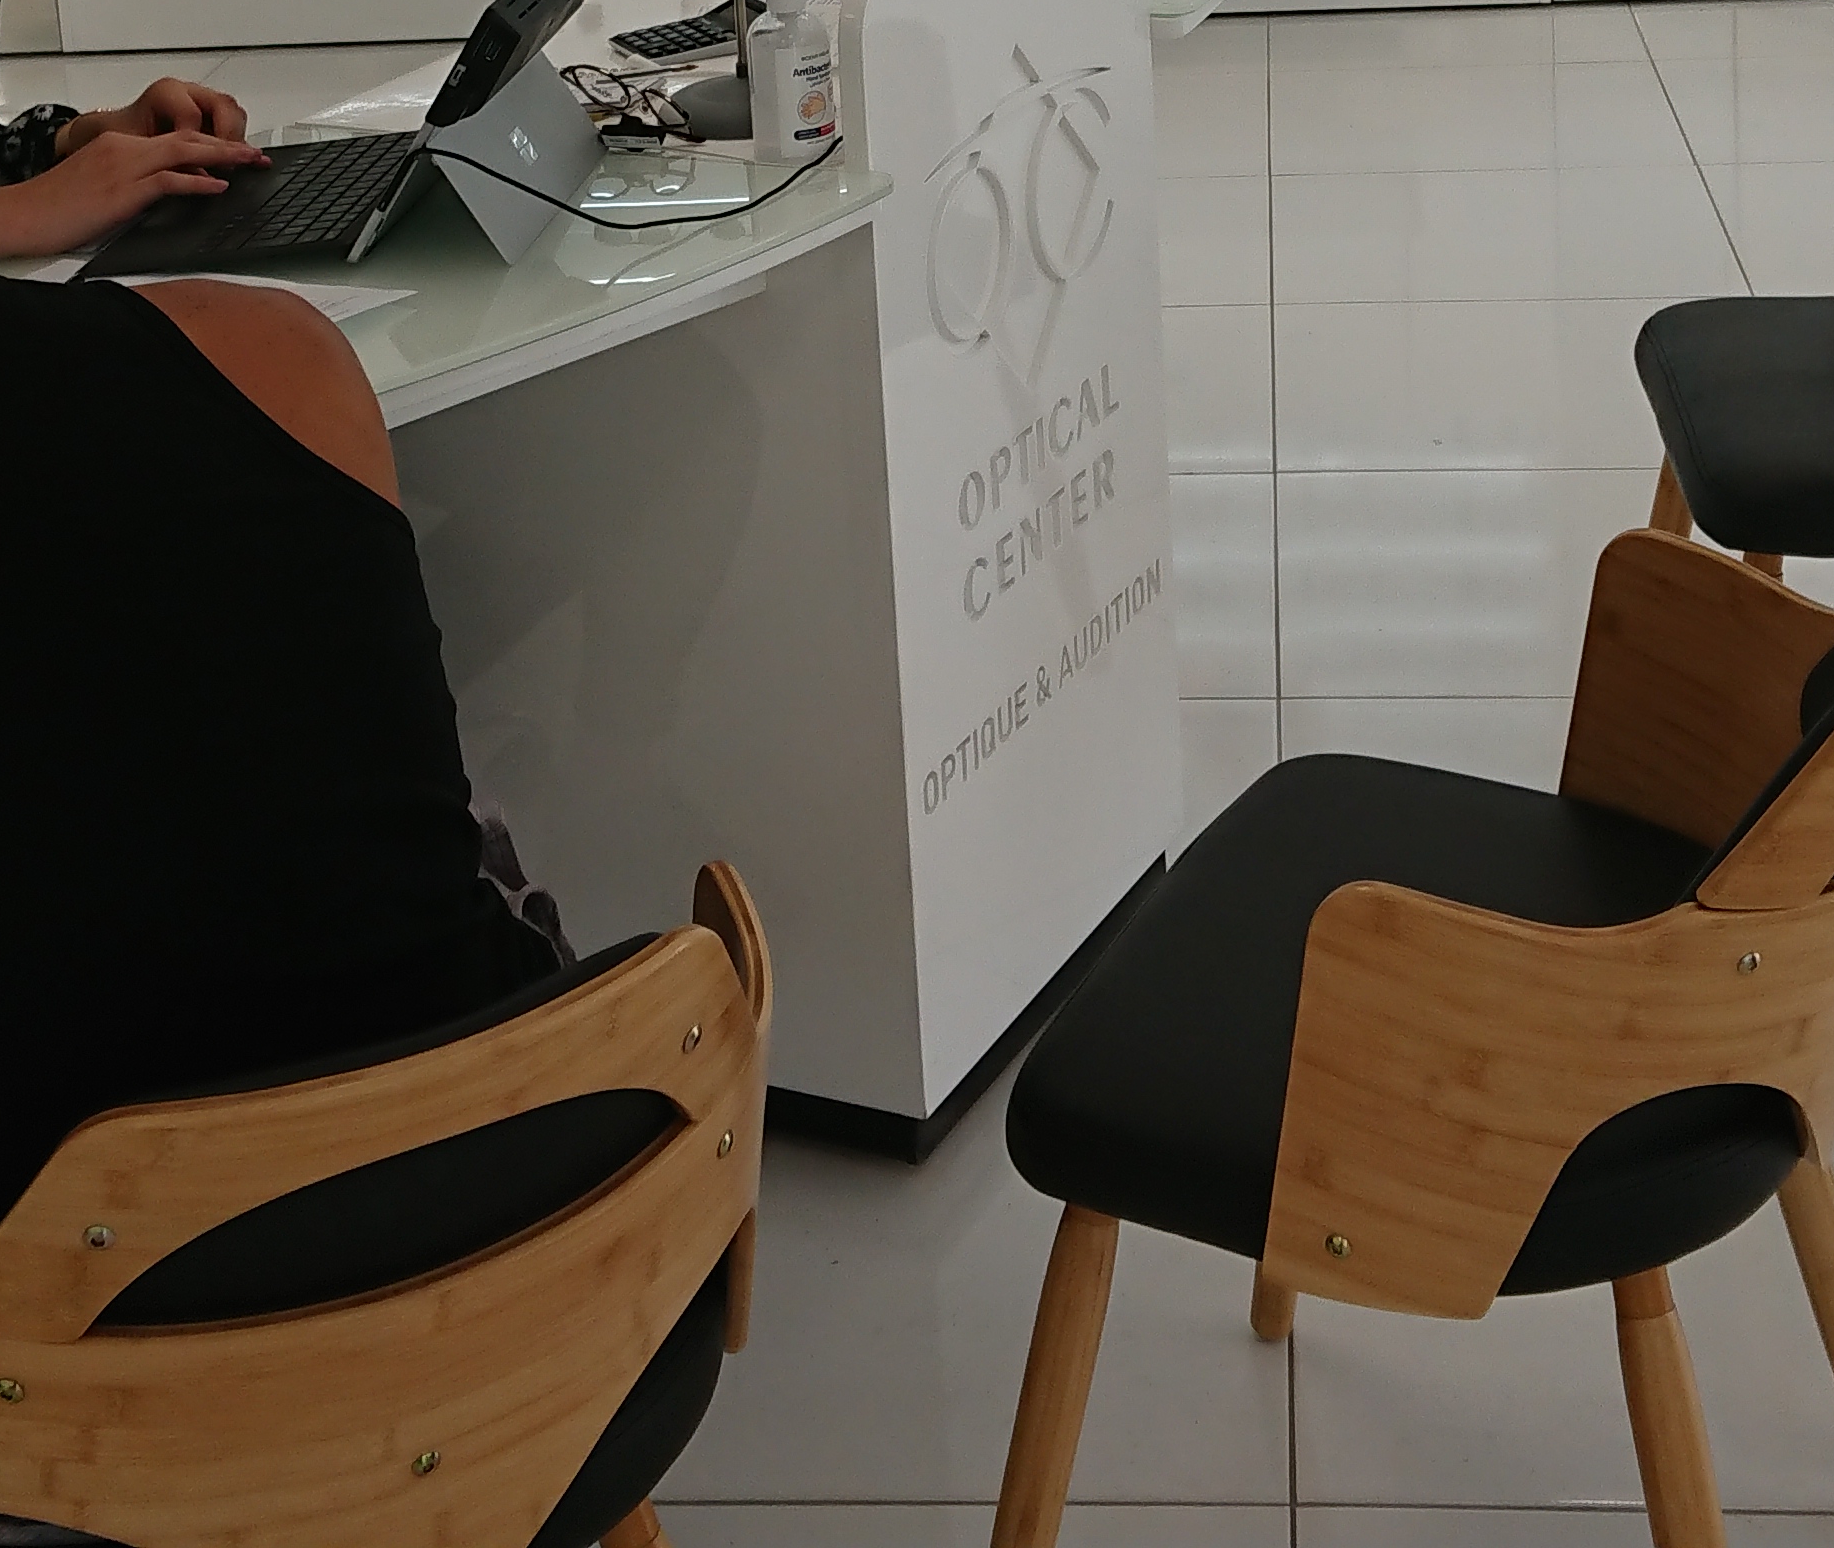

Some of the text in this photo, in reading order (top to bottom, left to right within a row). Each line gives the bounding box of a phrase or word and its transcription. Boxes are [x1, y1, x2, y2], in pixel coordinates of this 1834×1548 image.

[958, 364, 1121, 532] OPTICAL
[963, 448, 1116, 621] CENTER
[922, 559, 1163, 817] OPTIQUE & AUDITION
